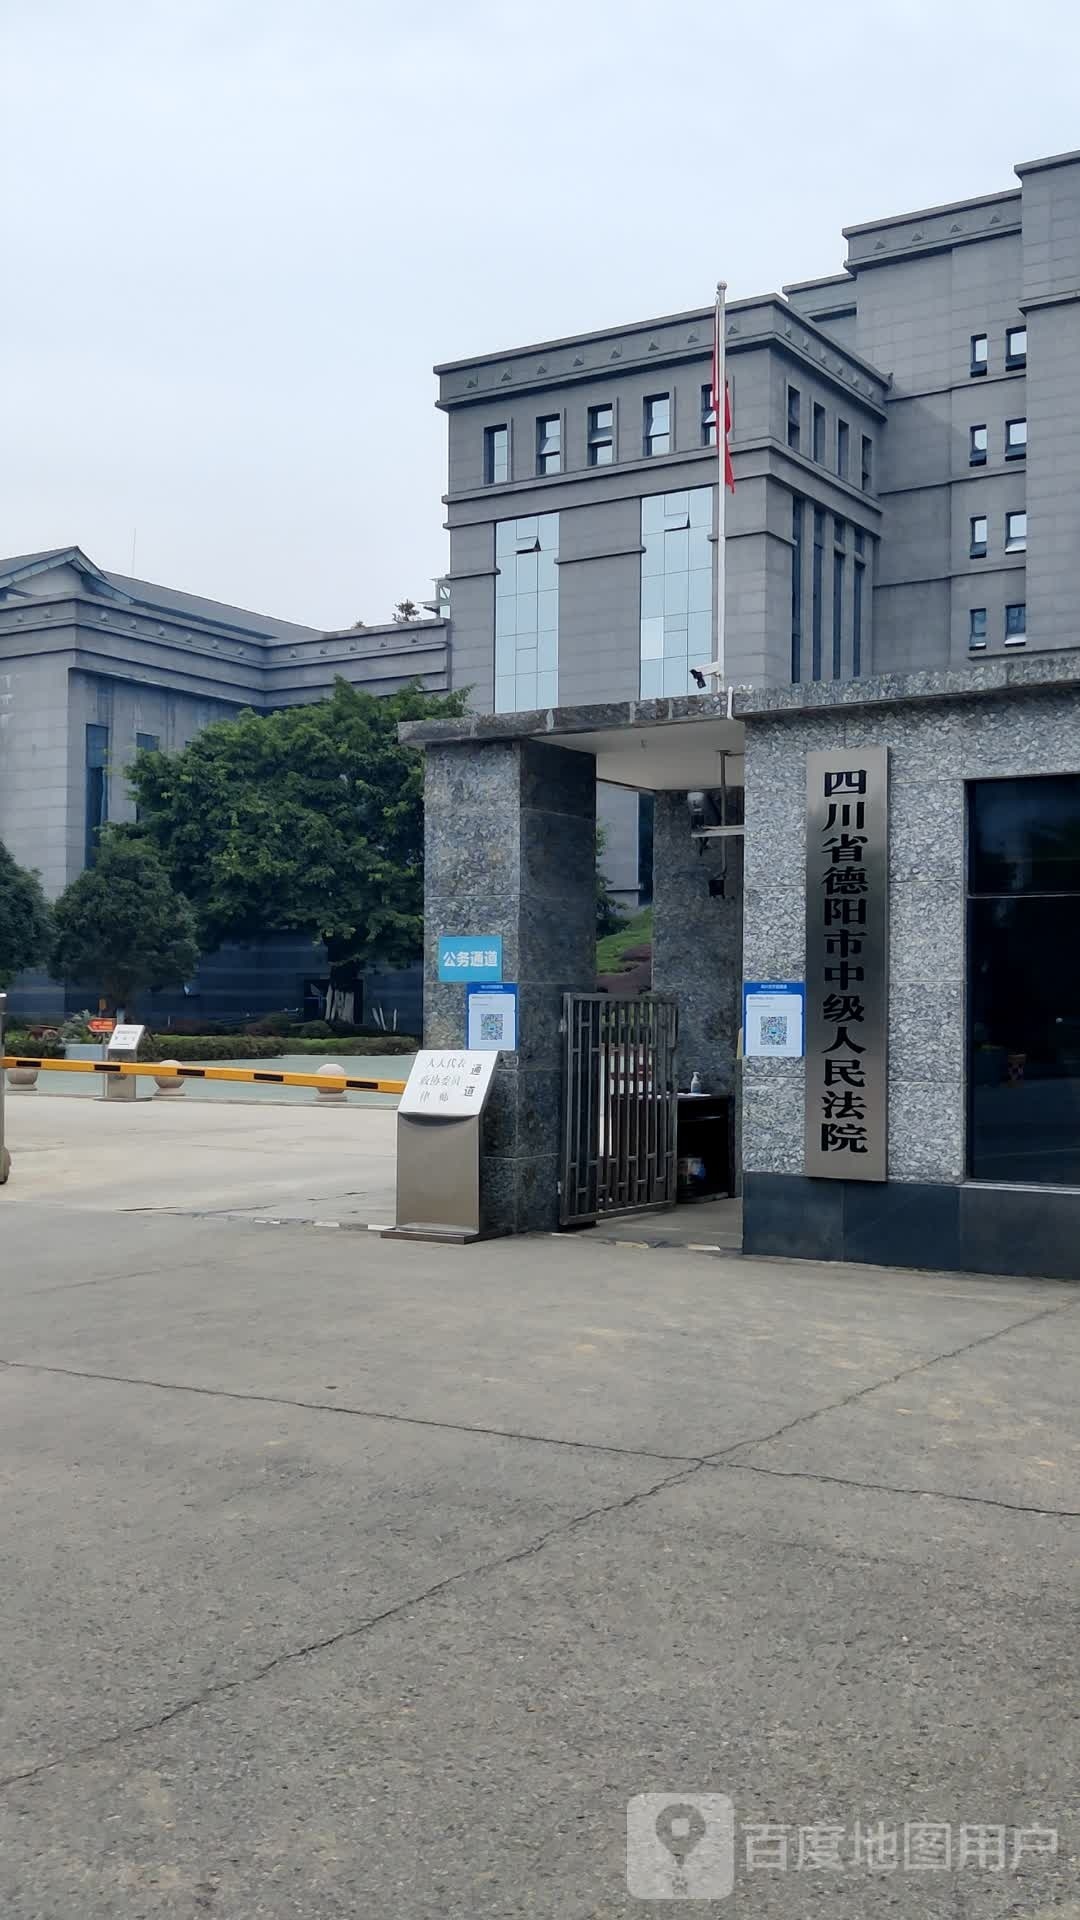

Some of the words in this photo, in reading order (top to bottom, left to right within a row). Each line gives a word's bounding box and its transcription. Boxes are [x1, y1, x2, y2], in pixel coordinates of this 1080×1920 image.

[443, 951, 498, 967] 公务通道
[821, 769, 868, 1154] 四川省德阳市中级人民法院
